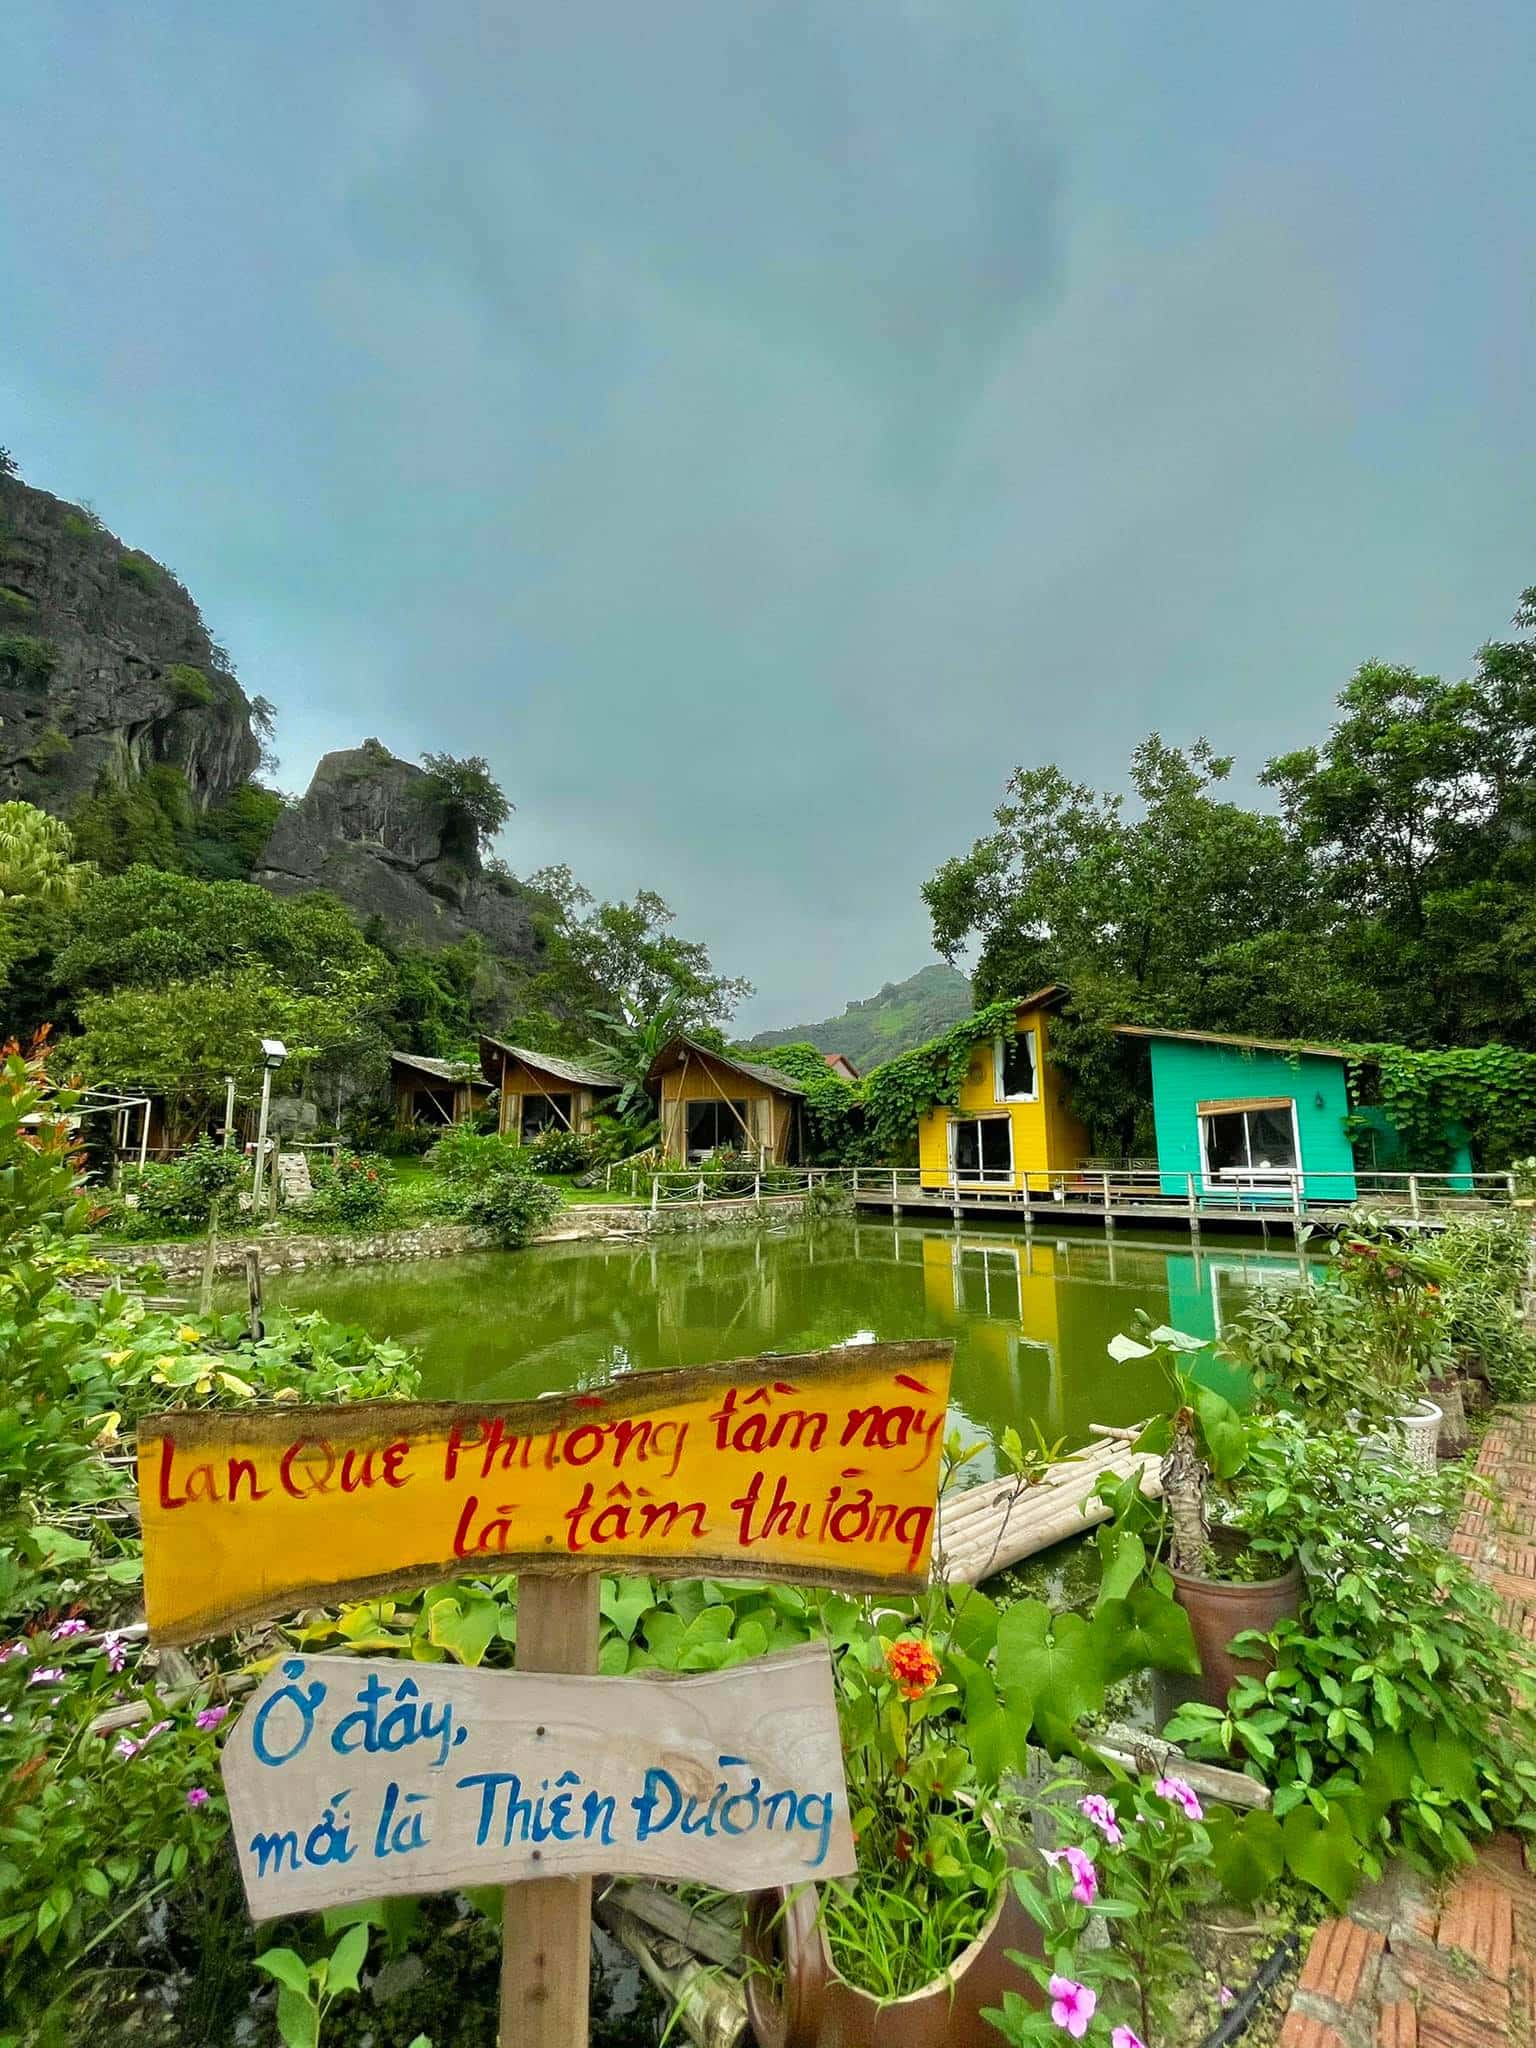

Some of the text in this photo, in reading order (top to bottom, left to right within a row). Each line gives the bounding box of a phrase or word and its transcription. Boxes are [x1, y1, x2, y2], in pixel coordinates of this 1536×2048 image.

[160, 1432, 272, 1509] Lan
[708, 1382, 828, 1454] tầm
[839, 1373, 946, 1473] này
[565, 1482, 713, 1552] tầm
[252, 1659, 468, 1768] Ở đây,
[249, 1788, 359, 1878] mới
[455, 1770, 618, 1847] Thiên
